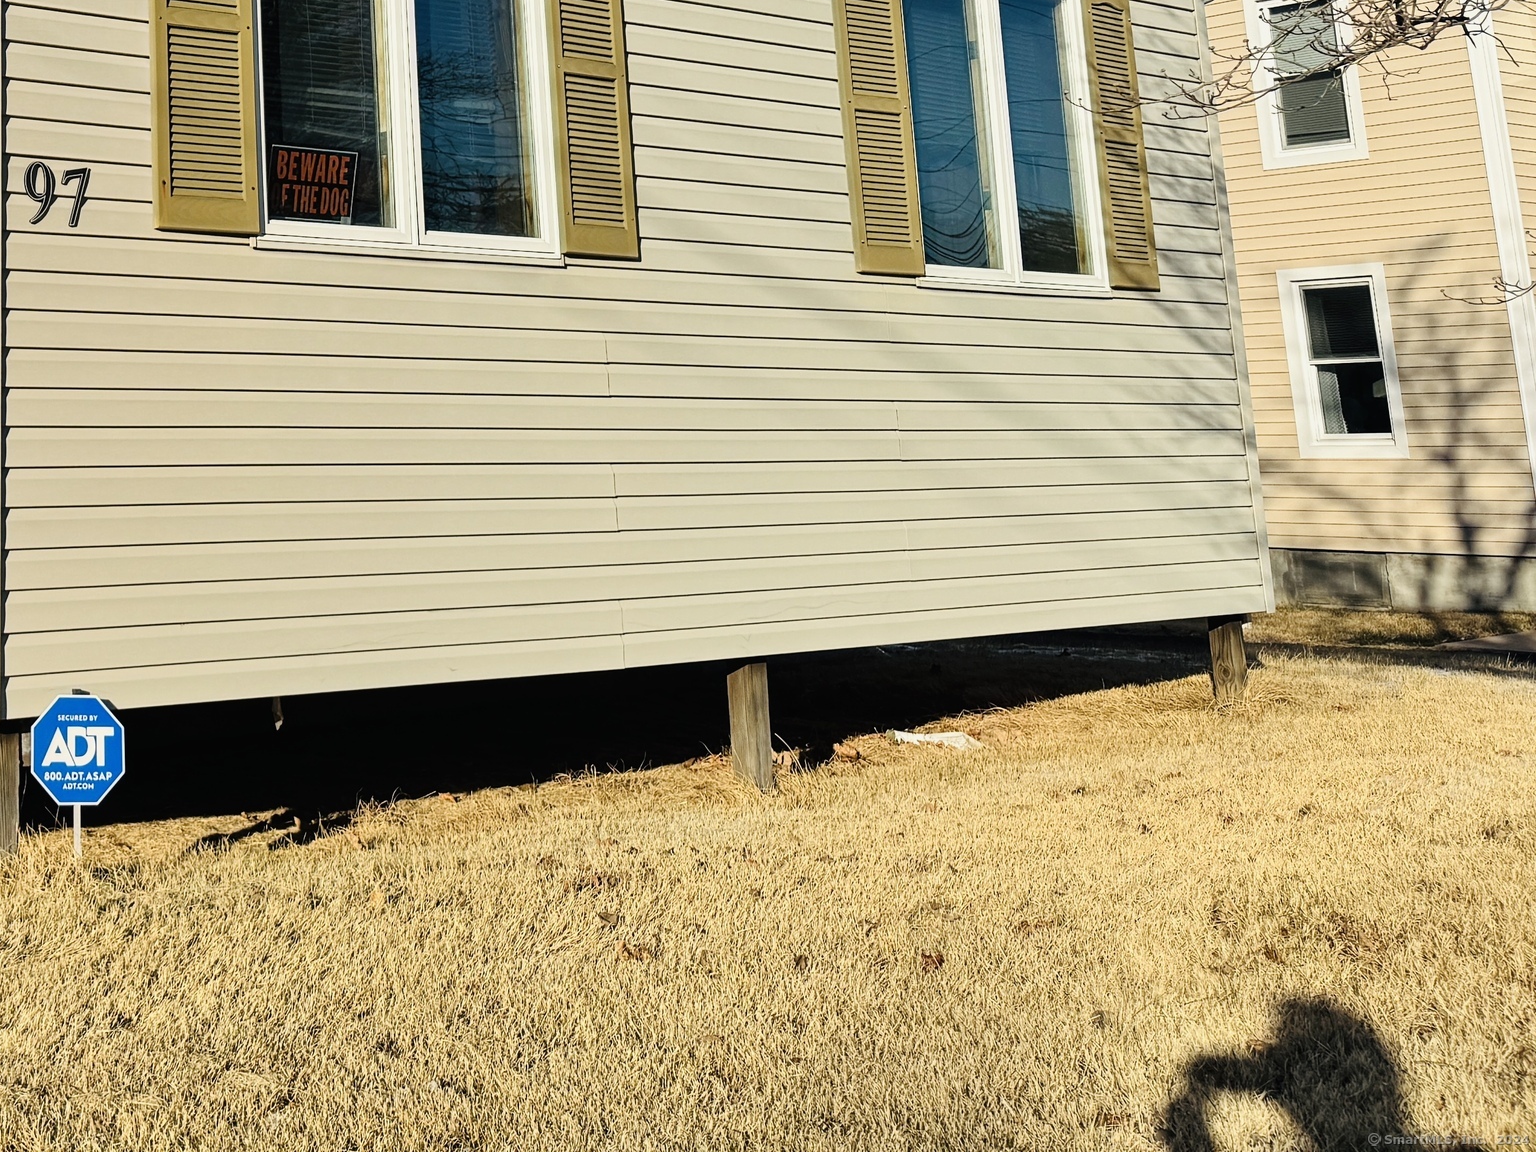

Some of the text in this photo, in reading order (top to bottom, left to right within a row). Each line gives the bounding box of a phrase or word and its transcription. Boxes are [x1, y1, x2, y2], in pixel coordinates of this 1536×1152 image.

[277, 150, 351, 186] BEWARE
[24, 161, 91, 228] 97
[293, 184, 319, 214] THE
[320, 187, 350, 216] DOG
[57, 714, 98, 722] SECURED BY
[41, 726, 115, 767] ADT
[44, 771, 113, 782] 800.ADT.ASAP
[62, 782, 95, 790] ADT.COM
